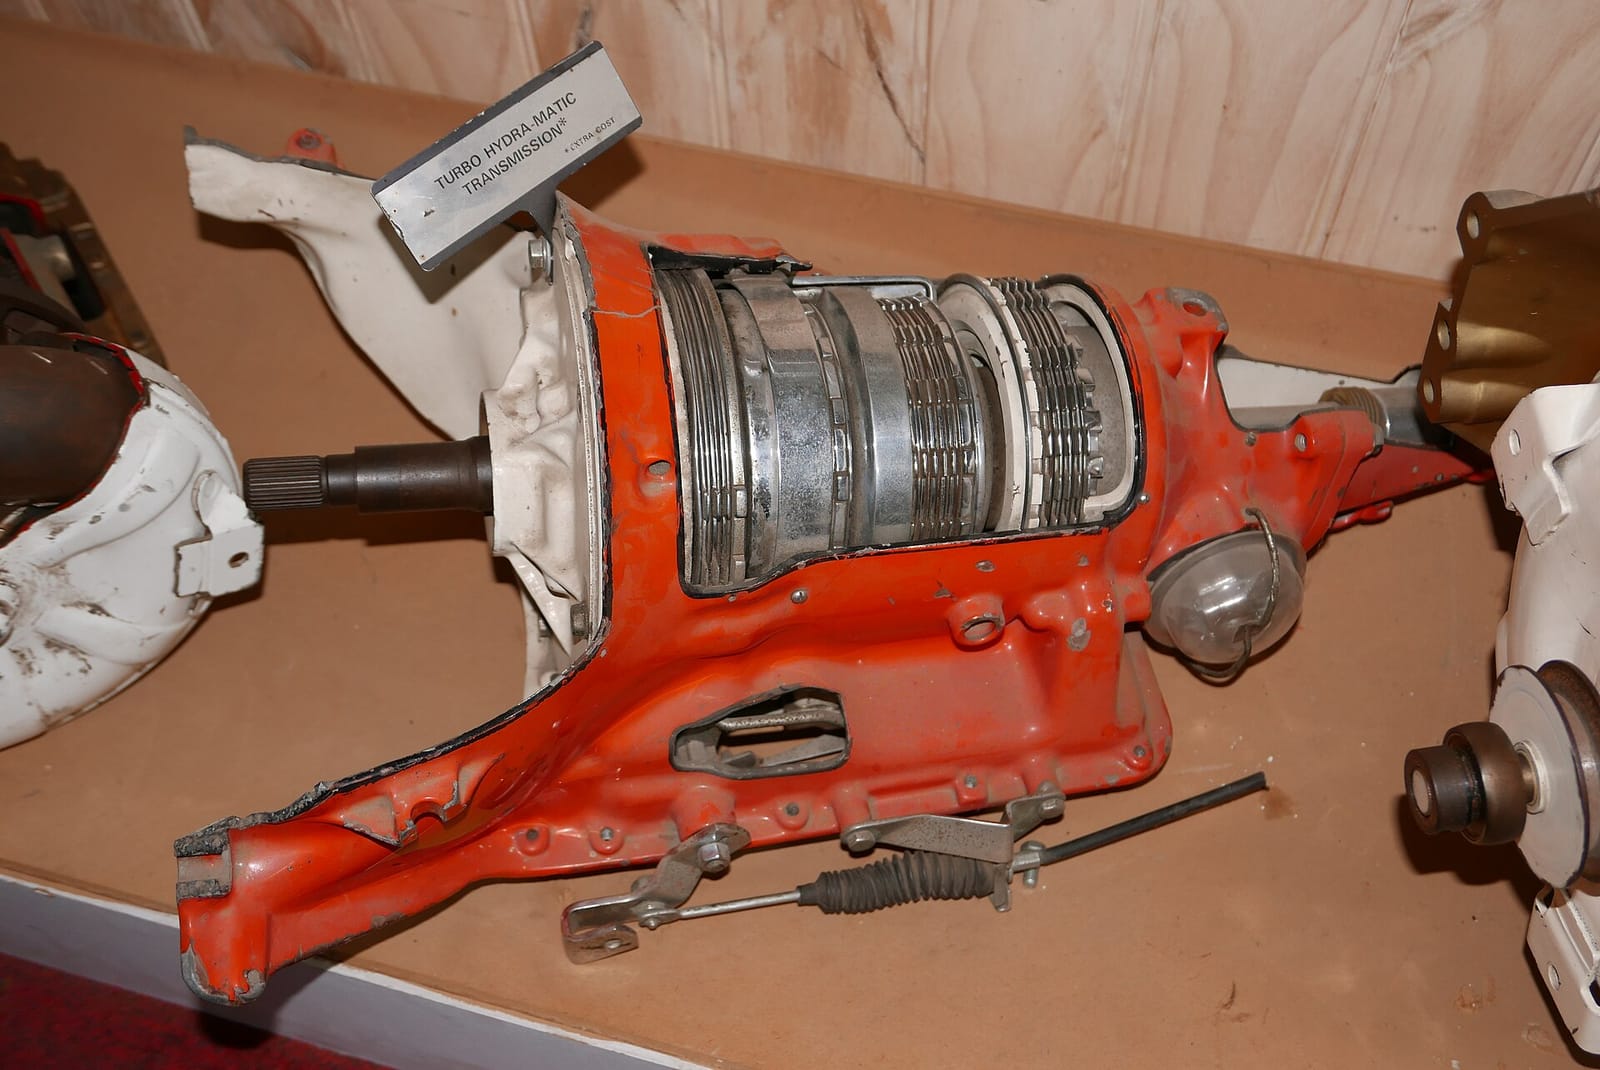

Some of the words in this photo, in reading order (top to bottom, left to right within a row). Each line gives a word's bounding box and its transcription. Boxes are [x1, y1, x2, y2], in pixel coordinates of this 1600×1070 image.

[434, 154, 482, 190] TURBO
[483, 92, 577, 159] HYDRA-MATIC
[595, 116, 616, 134] COST
